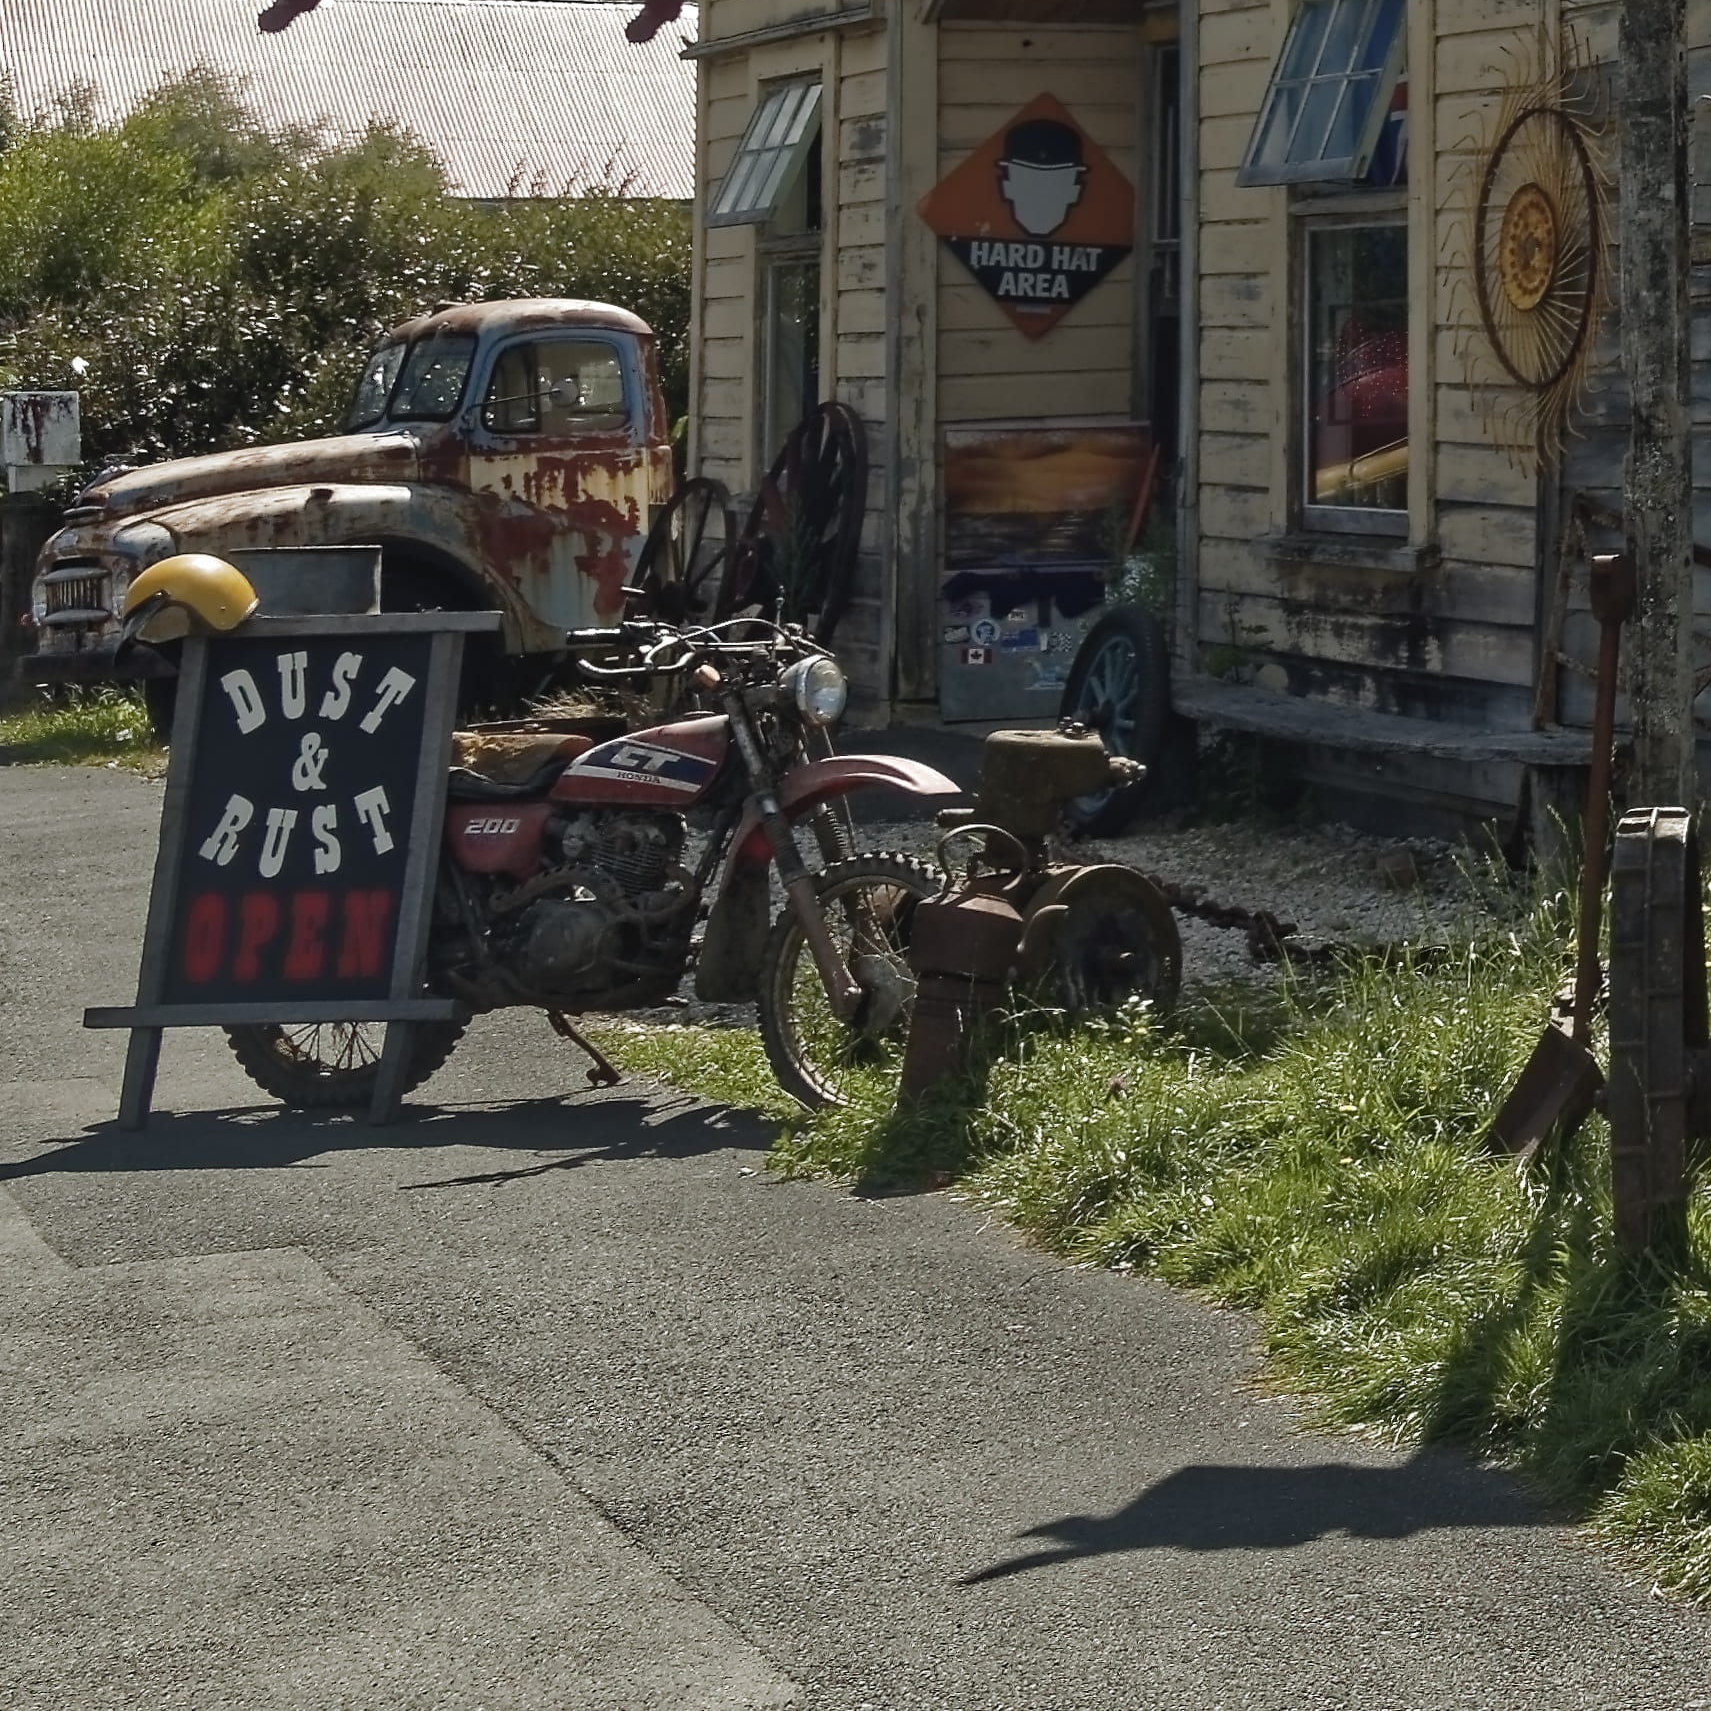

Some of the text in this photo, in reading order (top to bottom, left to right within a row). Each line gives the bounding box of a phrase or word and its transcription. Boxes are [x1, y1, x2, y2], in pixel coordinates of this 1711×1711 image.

[969, 241, 1103, 272] HARD HAT
[997, 271, 1070, 299] AREA
[220, 650, 417, 735] DUST
[292, 731, 328, 792] &
[616, 771, 662, 785] HONDA
[198, 785, 395, 879] RUST
[463, 817, 522, 835] 200
[183, 890, 393, 983] OPEN
